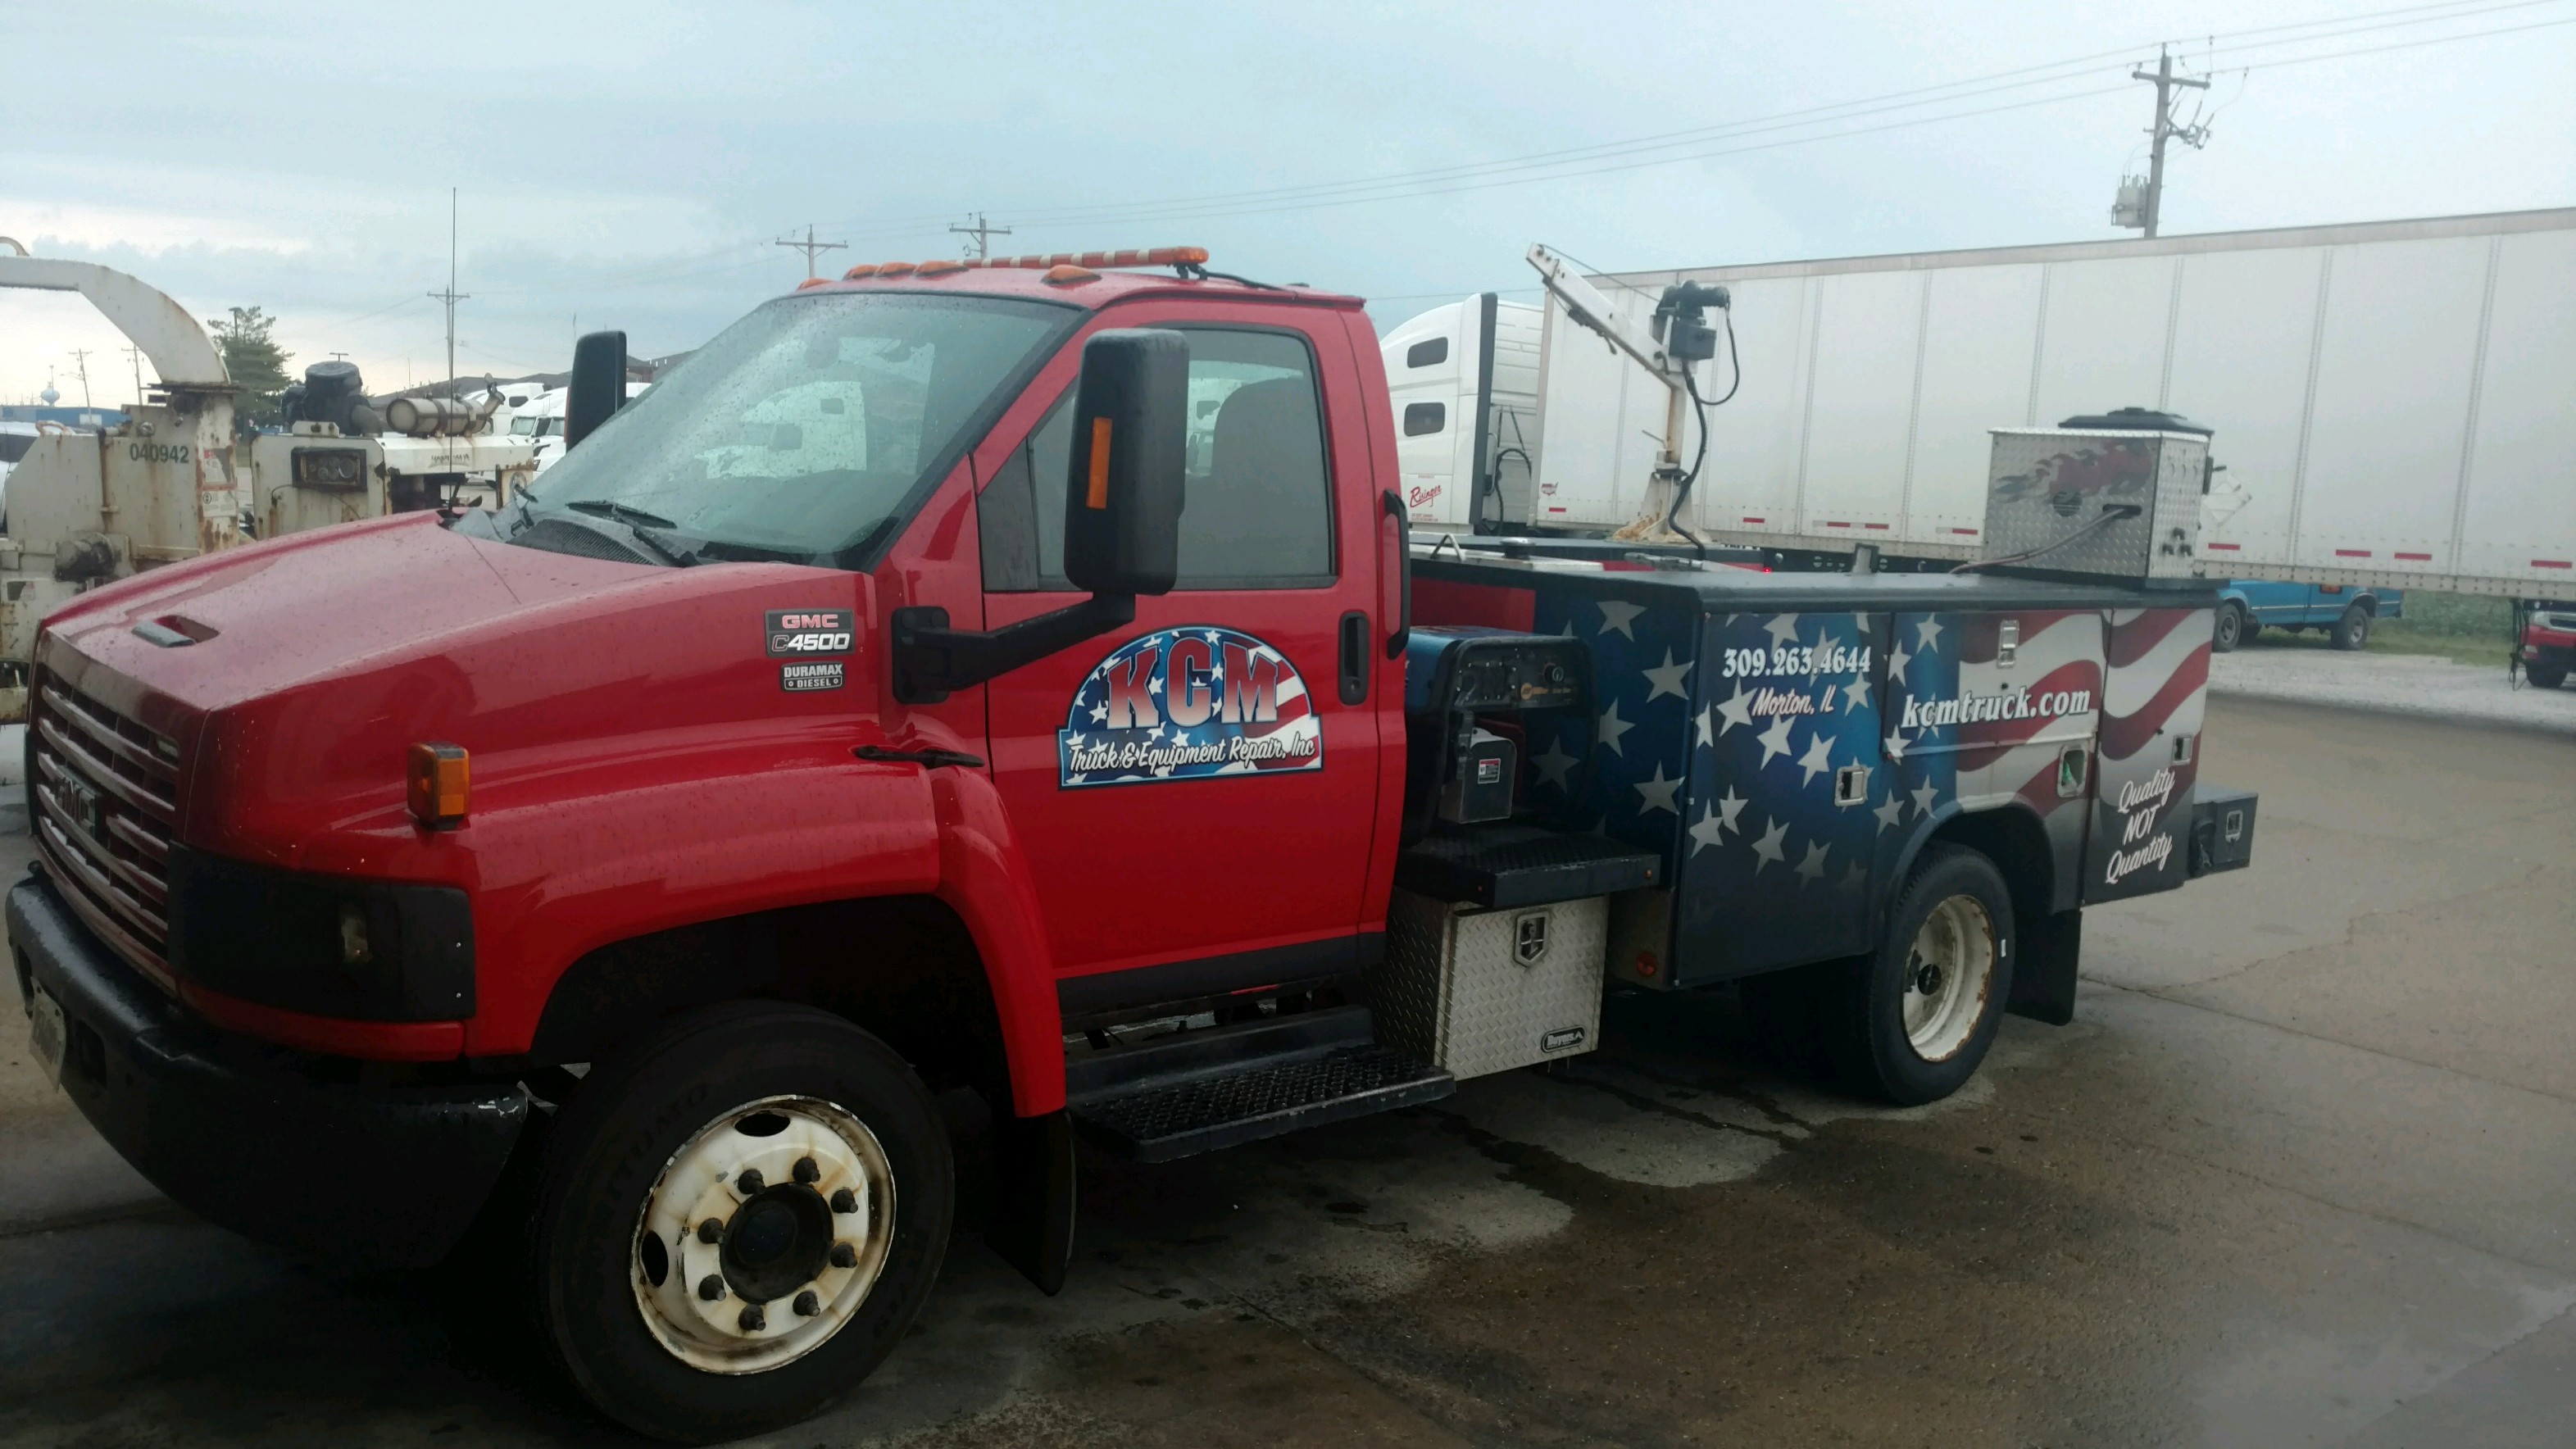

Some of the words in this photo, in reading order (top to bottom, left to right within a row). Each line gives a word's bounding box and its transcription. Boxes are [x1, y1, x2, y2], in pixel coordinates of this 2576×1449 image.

[129, 443, 189, 464] 040942
[782, 614, 838, 629] GMC
[771, 633, 851, 652] C4500
[784, 664, 843, 678] DURAMAX
[1722, 646, 1871, 678] 309.263.4644
[797, 678, 831, 688] DIESEL
[1106, 636, 1278, 729] KCM
[1751, 687, 1815, 717] Morton,
[1820, 684, 1837, 713] IL
[1901, 685, 2091, 729] kcmtruck.com
[1069, 743, 1120, 771] Truck
[1120, 742, 1138, 768] &
[1137, 738, 1226, 774] Equipment
[2117, 767, 2176, 814] Quality
[2122, 804, 2160, 846] NOT
[2105, 832, 2172, 884] Quantity
